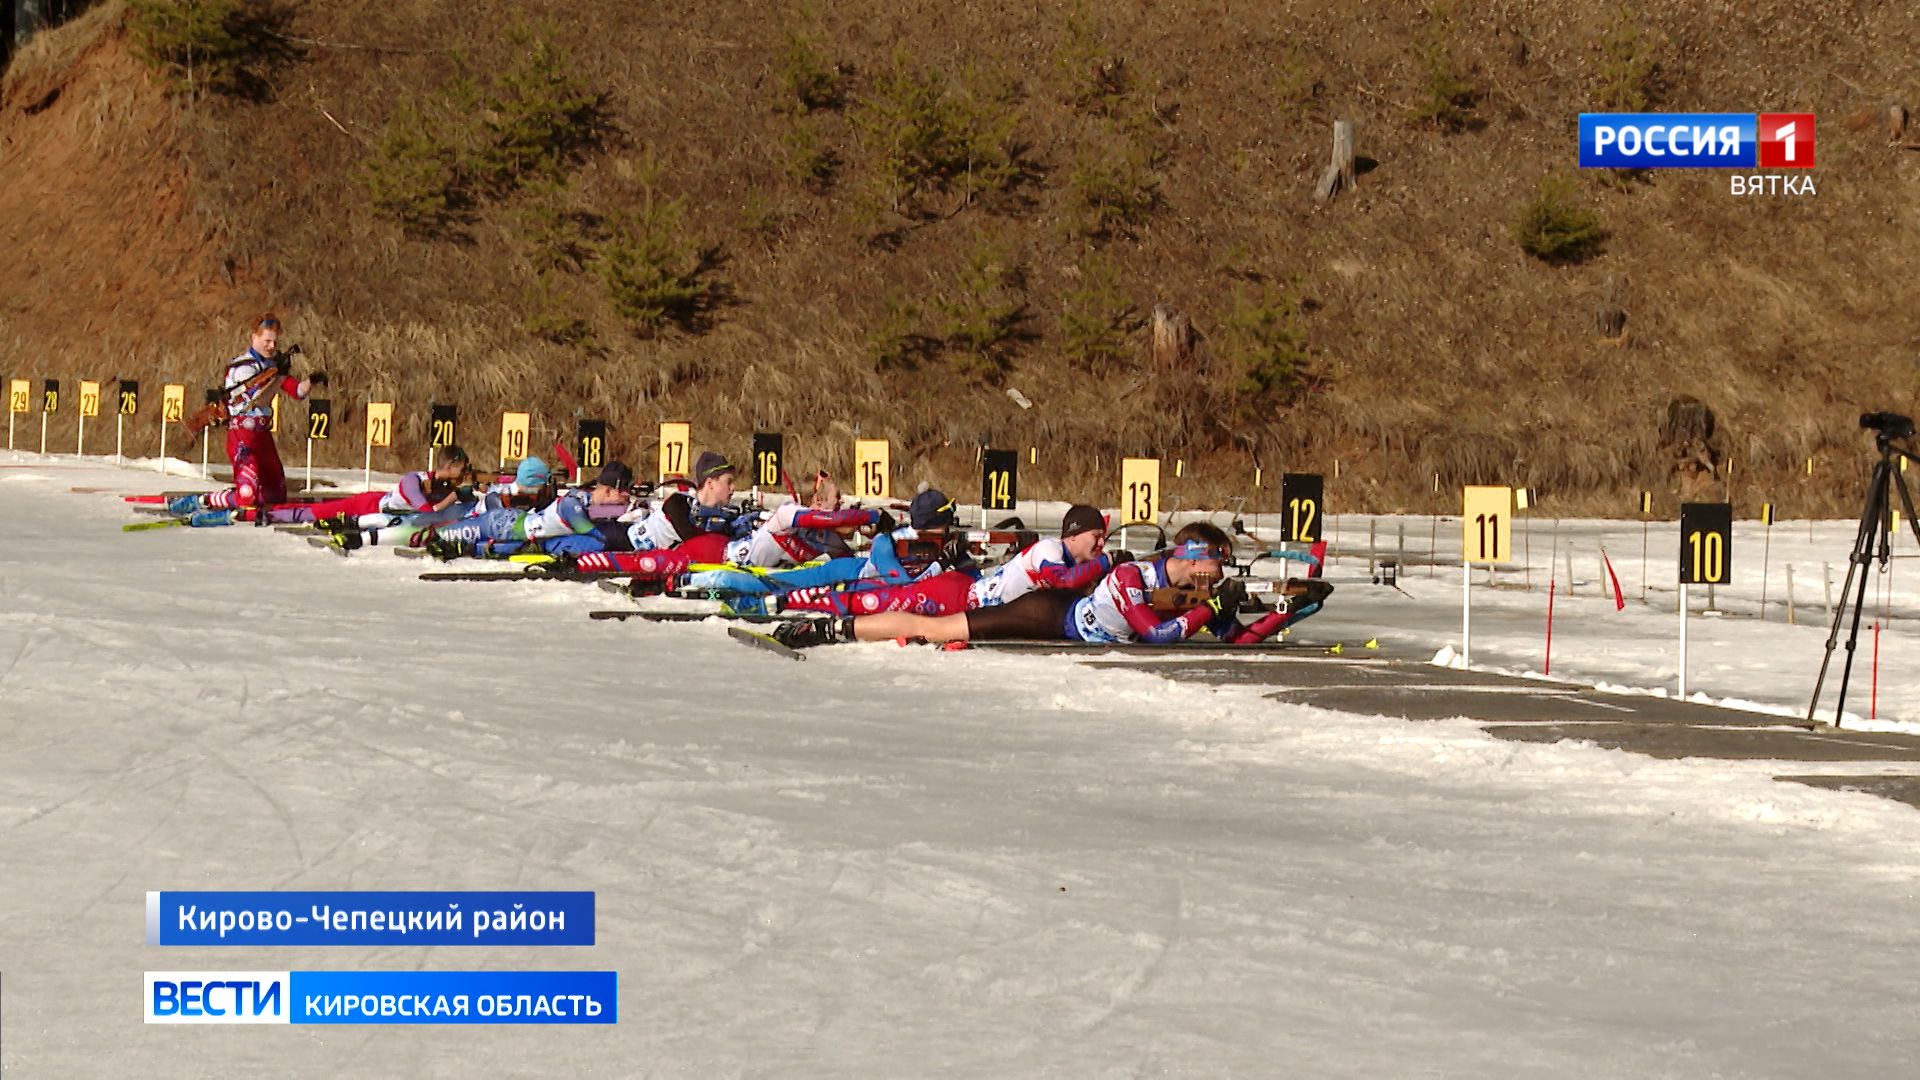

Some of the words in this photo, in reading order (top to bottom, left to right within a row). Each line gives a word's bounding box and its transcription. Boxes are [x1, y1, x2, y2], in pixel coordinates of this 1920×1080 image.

[12, 390, 27, 411] 29
[44, 390, 58, 413] 28
[83, 392, 97, 415] 27
[120, 391, 137, 415] 26
[165, 397, 181, 421] 25
[310, 412, 329, 439] 22
[371, 416, 387, 444] 21
[432, 419, 454, 447] 20
[506, 429, 524, 458] 19
[582, 436, 601, 467] 18
[666, 441, 683, 472] 17
[757, 450, 778, 486] 16
[861, 460, 883, 496] 15
[988, 470, 1011, 508] 14
[1128, 481, 1152, 521] 13
[1289, 497, 1316, 543] 12
[1475, 513, 1498, 560] 11
[1688, 530, 1723, 583] 10
